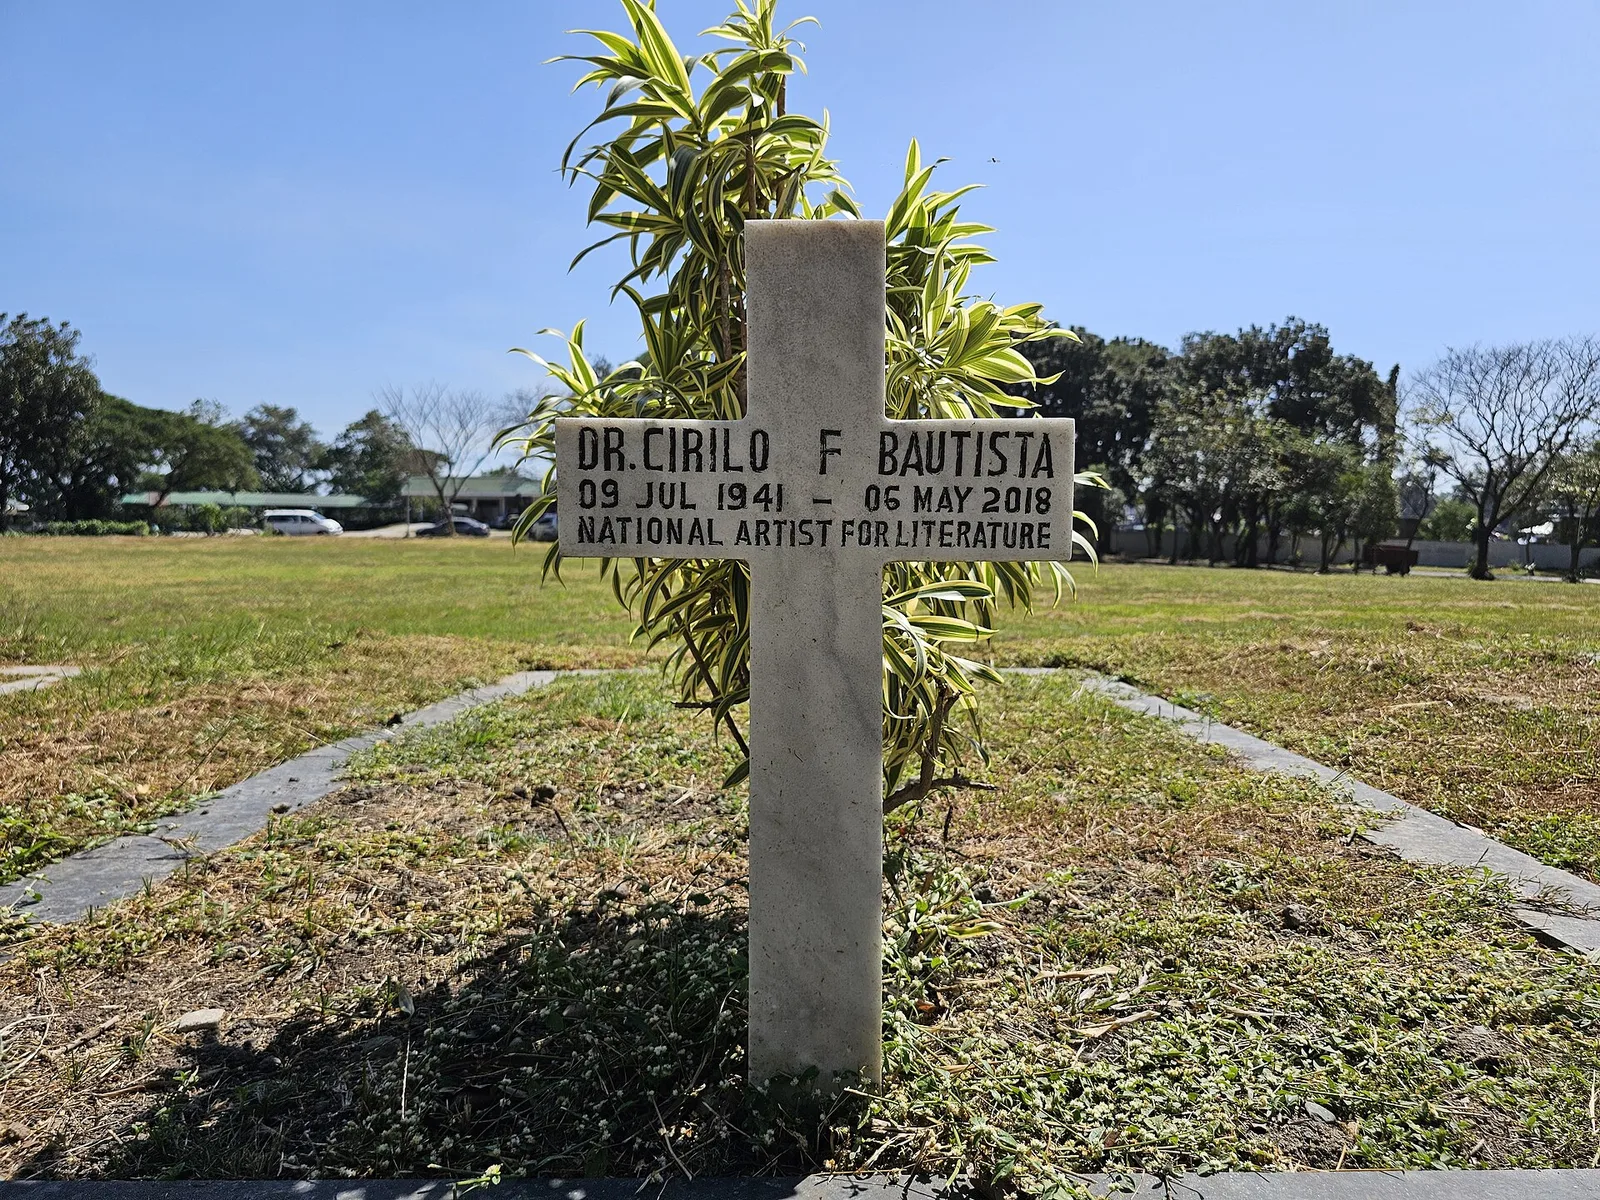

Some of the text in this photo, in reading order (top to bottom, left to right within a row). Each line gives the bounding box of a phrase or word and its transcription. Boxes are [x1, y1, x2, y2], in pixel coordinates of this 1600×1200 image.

[819, 428, 842, 475] F
[878, 429, 1053, 478] BAUTISTA
[579, 478, 621, 511] 09
[635, 482, 696, 510] JUL
[718, 482, 785, 512] 1941
[865, 484, 900, 513] 06
[913, 485, 973, 514] MAY
[981, 486, 1052, 515] 2018
[578, 516, 1051, 549] NATIONAL ARTIST FOR LITERATURE
